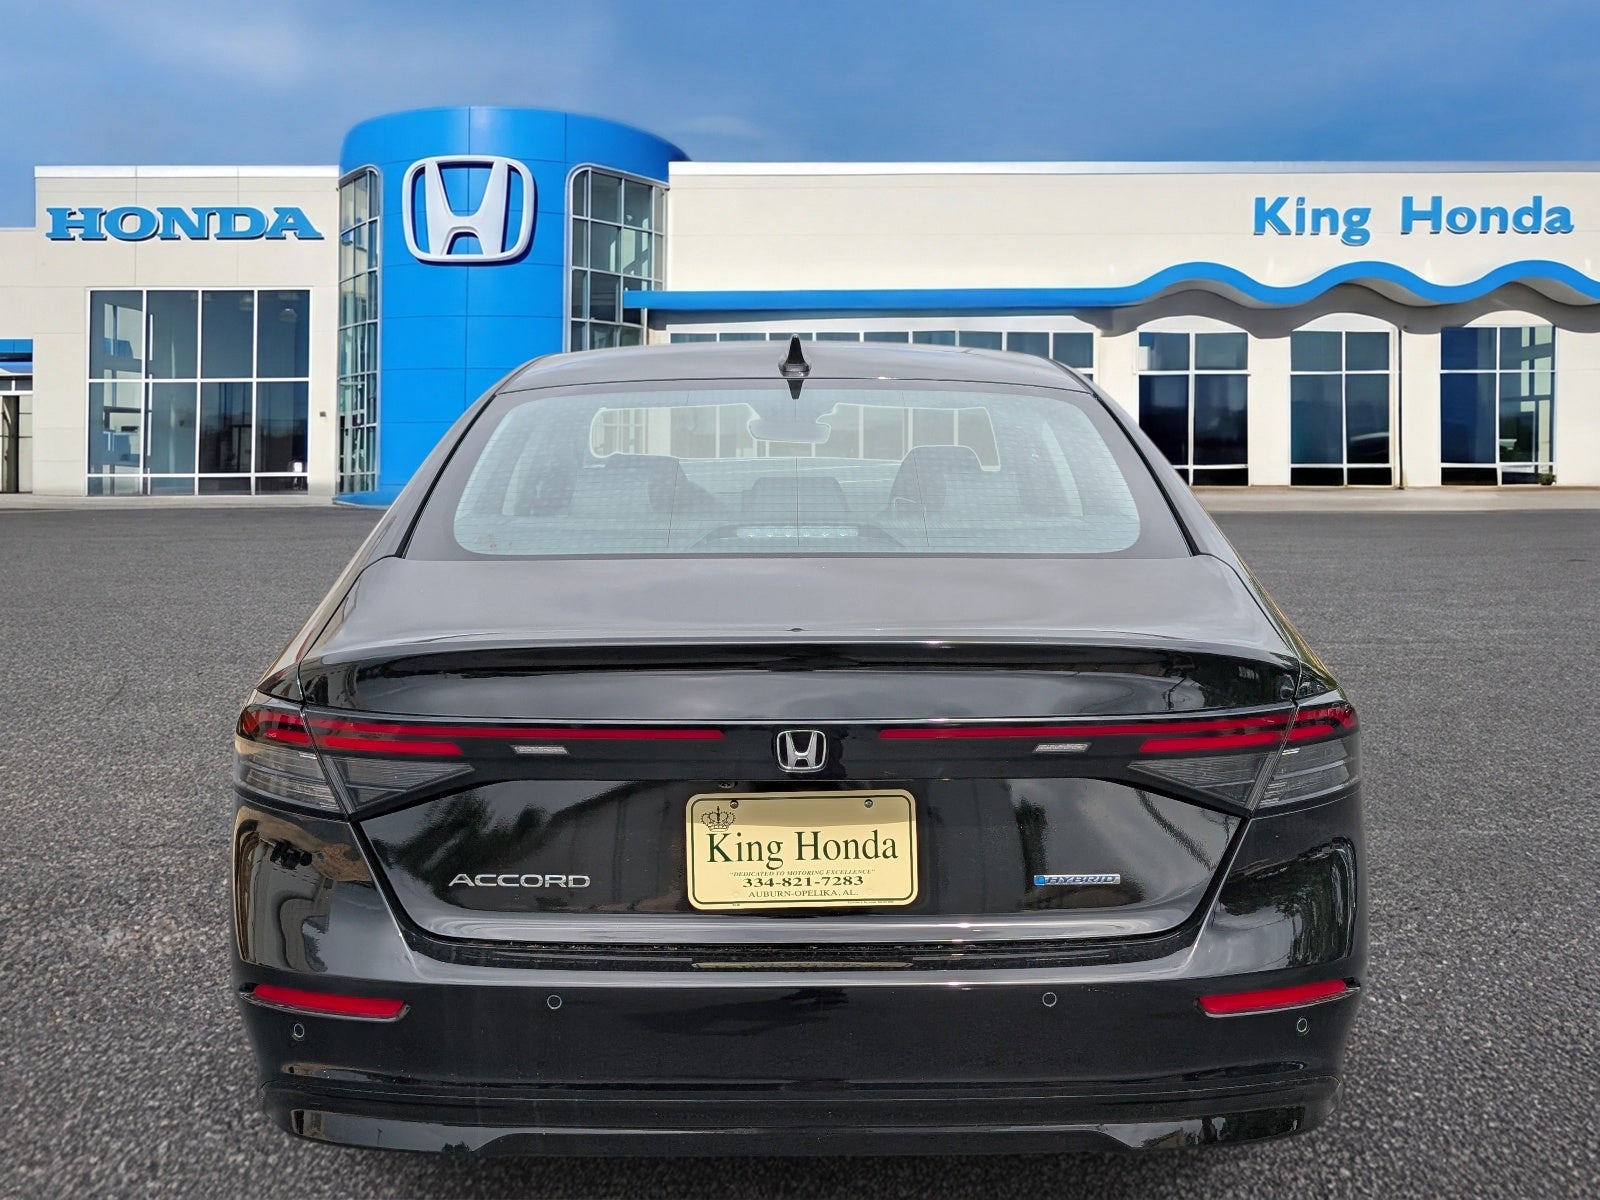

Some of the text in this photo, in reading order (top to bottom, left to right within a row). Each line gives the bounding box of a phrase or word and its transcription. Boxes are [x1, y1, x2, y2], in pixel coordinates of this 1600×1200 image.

[46, 206, 325, 241] HONDA
[1253, 195, 1575, 246] King Honda
[706, 830, 899, 870] King Honda
[448, 873, 591, 888] ACCORD
[742, 875, 864, 888] 334-821-7283
[1046, 875, 1117, 884] HYBRID
[748, 889, 841, 898] AUBURN-OPELIKA,
